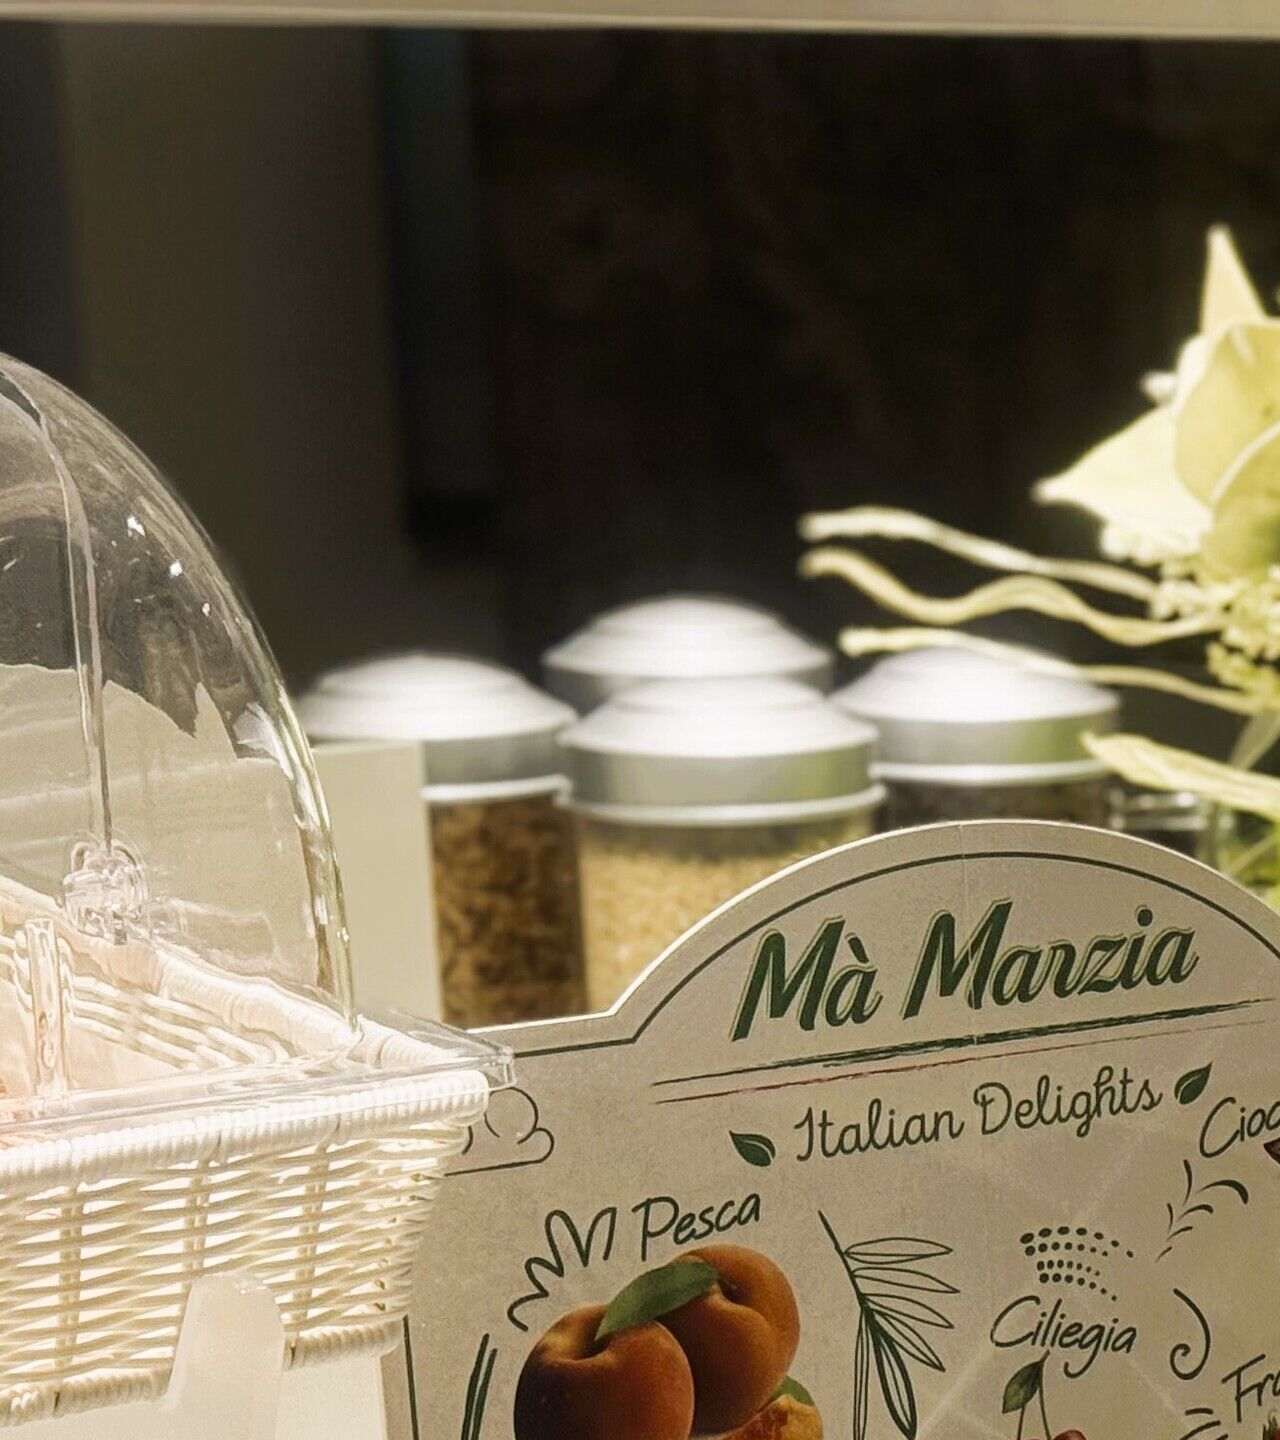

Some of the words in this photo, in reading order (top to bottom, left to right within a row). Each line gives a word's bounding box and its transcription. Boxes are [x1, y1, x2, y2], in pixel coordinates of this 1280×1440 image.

[731, 915, 883, 1042] Mà
[902, 898, 1200, 1020] Marzia
[794, 1099, 965, 1162] Italian
[974, 1065, 1163, 1138] Delights
[632, 1193, 762, 1261] Pesca
[990, 1296, 1138, 1378] Ciliegia
